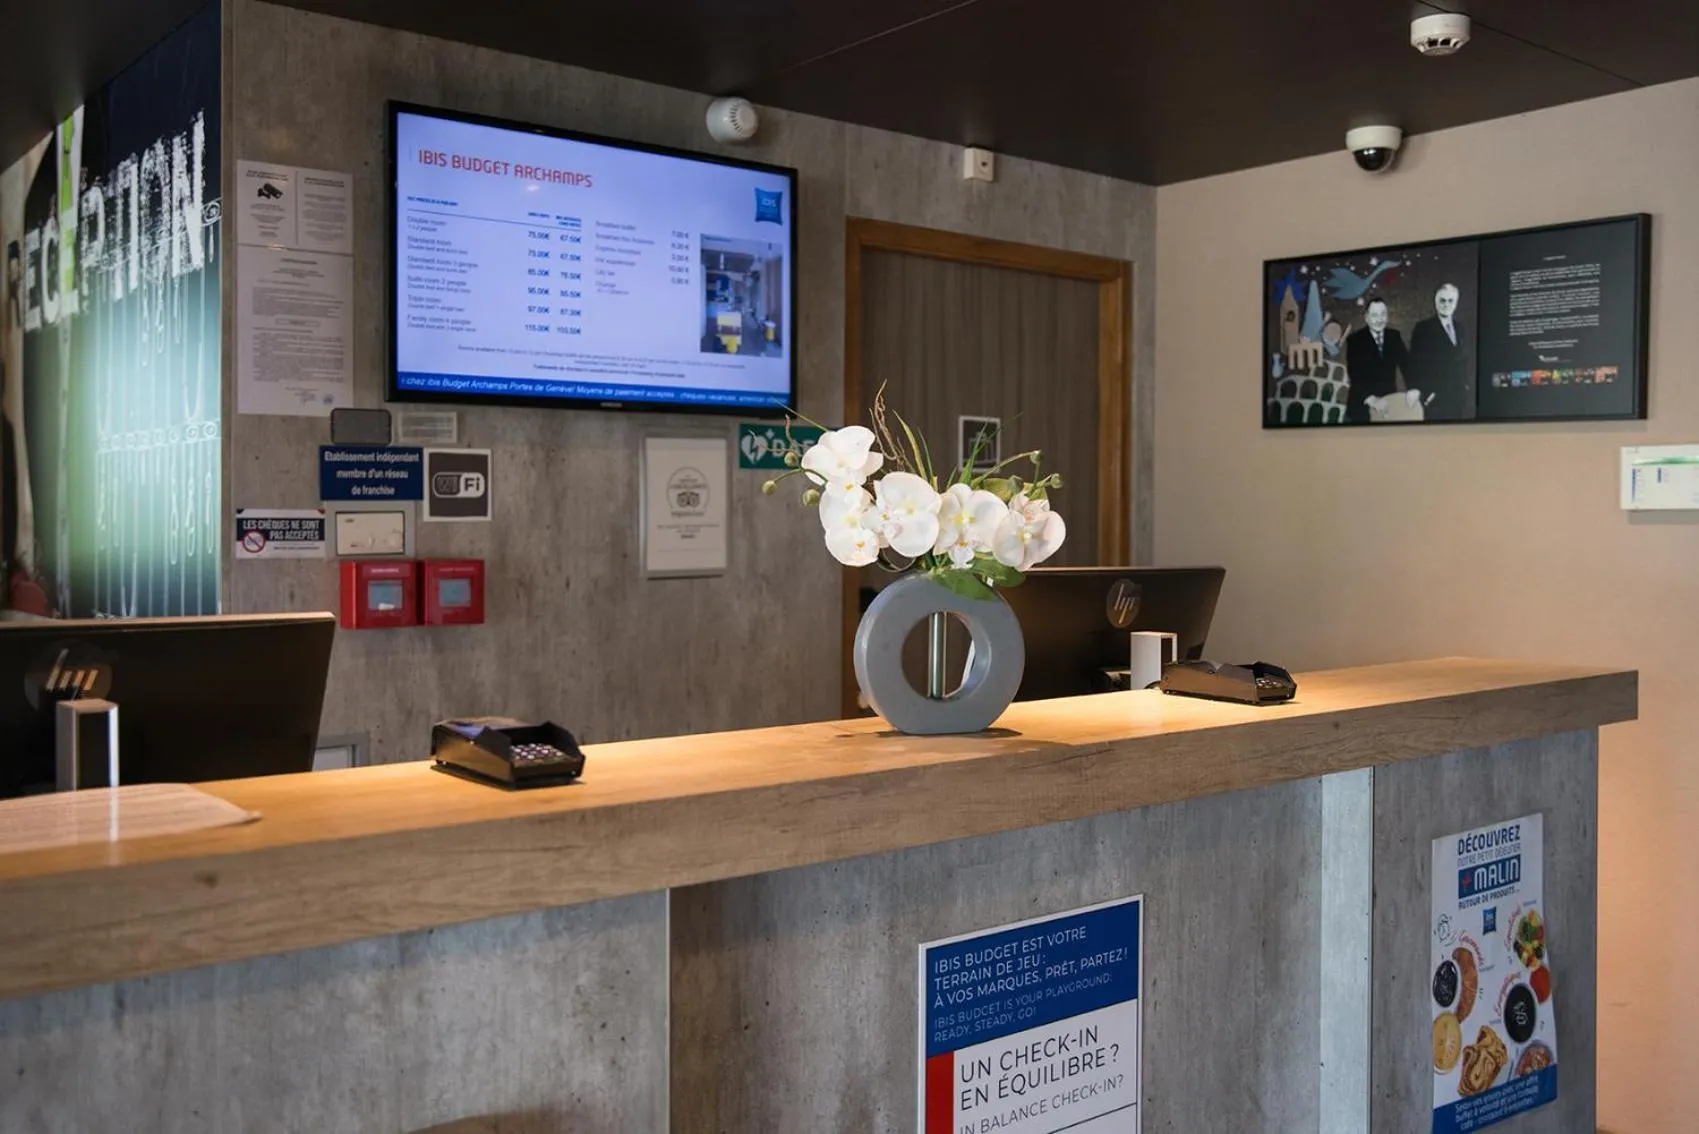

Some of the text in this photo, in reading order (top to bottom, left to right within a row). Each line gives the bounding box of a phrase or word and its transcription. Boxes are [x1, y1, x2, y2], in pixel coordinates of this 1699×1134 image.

[419, 149, 593, 188] IBIS BUDGET ARCHAMPS
[442, 378, 471, 390] Budget
[324, 451, 420, 464] Etablissement indépendant
[336, 468, 366, 478] membre
[351, 485, 395, 495] de franchise
[243, 519, 257, 529] LES
[291, 519, 299, 529] NE
[301, 519, 320, 529] SONT
[270, 530, 284, 540] PAS
[1114, 583, 1136, 624] hp
[1458, 824, 1521, 856] DÉCOUVREZ
[1474, 859, 1519, 891] MALIN
[935, 926, 1087, 974] IBIS BUDGET EST VOTRE
[934, 991, 944, 1009] À
[946, 985, 974, 1005] VOS
[977, 970, 1042, 1000] MARQUES,
[1045, 958, 1077, 978] PRÊT,
[935, 964, 992, 991] TERRAIN
[997, 962, 1013, 976] DE
[934, 1013, 955, 1029] IBIS
[958, 1002, 1001, 1024] BUDGET
[1003, 998, 1013, 1011] IS
[1015, 991, 1043, 1008] YOUR
[934, 1007, 1036, 1044] READY, STEADY, GO!
[961, 1024, 1099, 1084] UN CHECK-IN
[961, 1083, 989, 1111] EN
[980, 1099, 1048, 1132] BALANCE
[1051, 1073, 1125, 1110] CHECK-IN?
